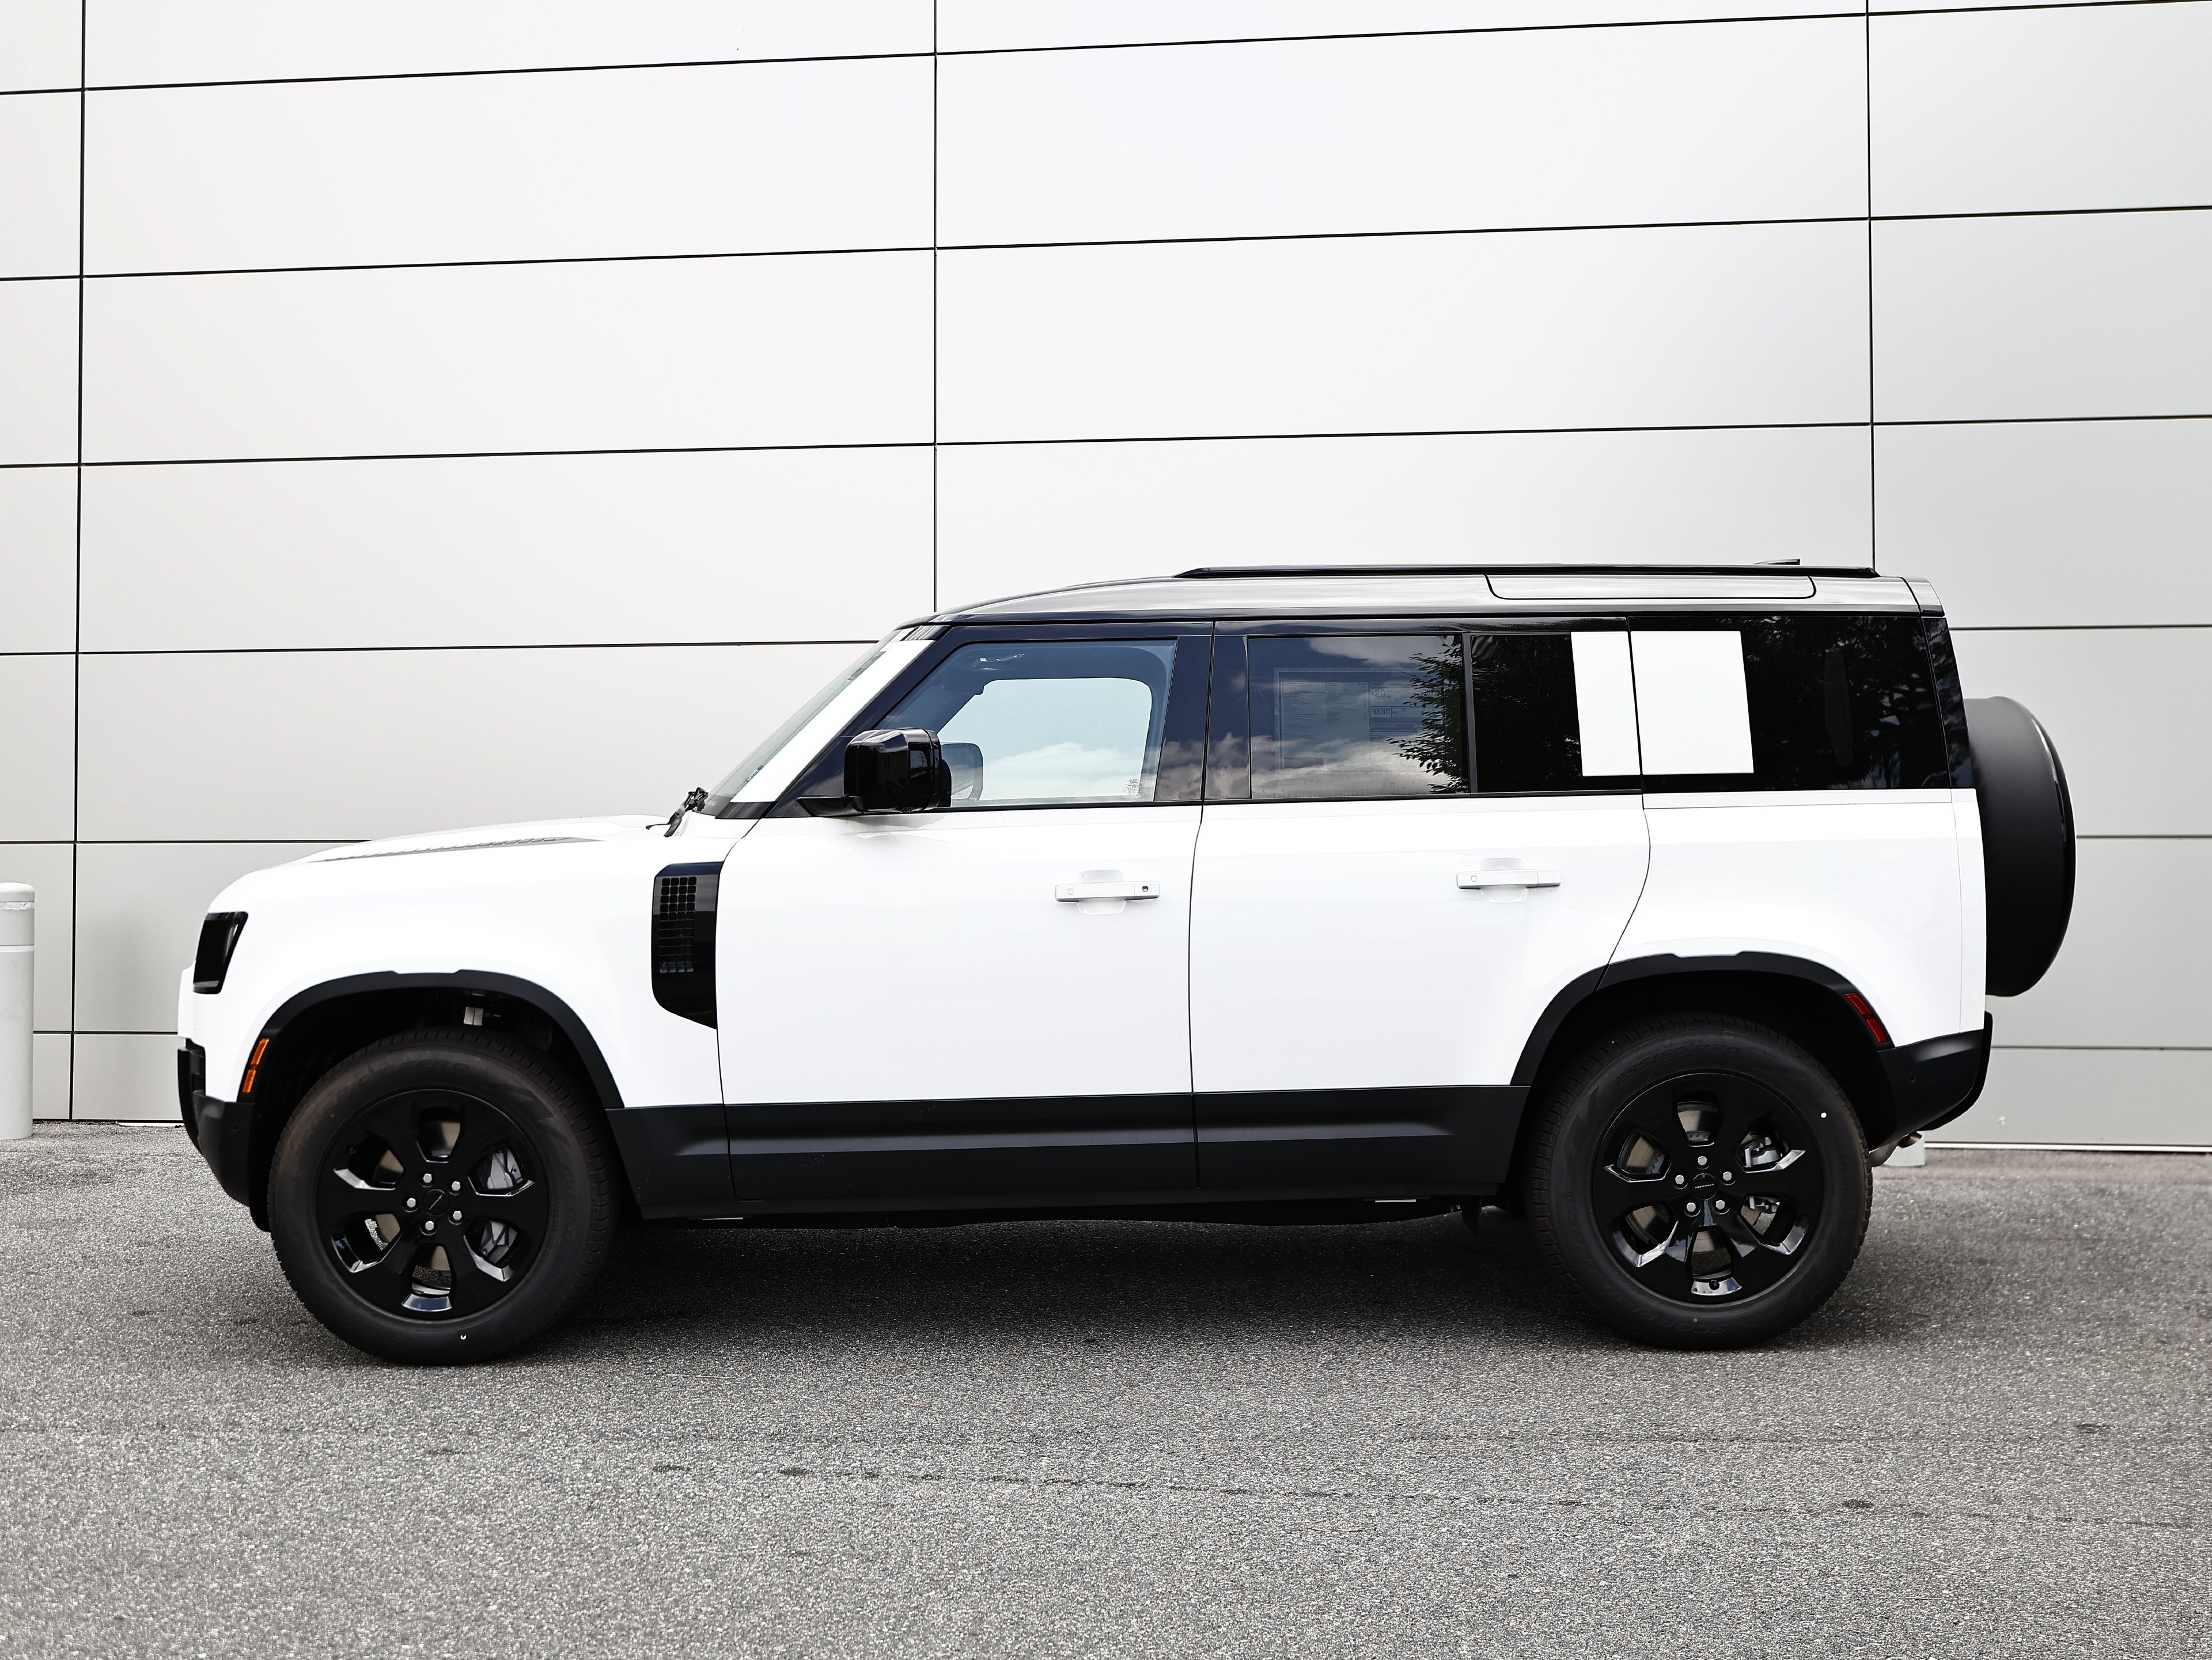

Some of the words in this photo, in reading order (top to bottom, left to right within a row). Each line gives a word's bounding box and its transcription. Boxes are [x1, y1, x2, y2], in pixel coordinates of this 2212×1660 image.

[1374, 689, 1386, 697] 20
[398, 1060, 471, 1074] ZERO
[1615, 1045, 1689, 1087] 255/60
[1694, 1043, 1743, 1056] R20
